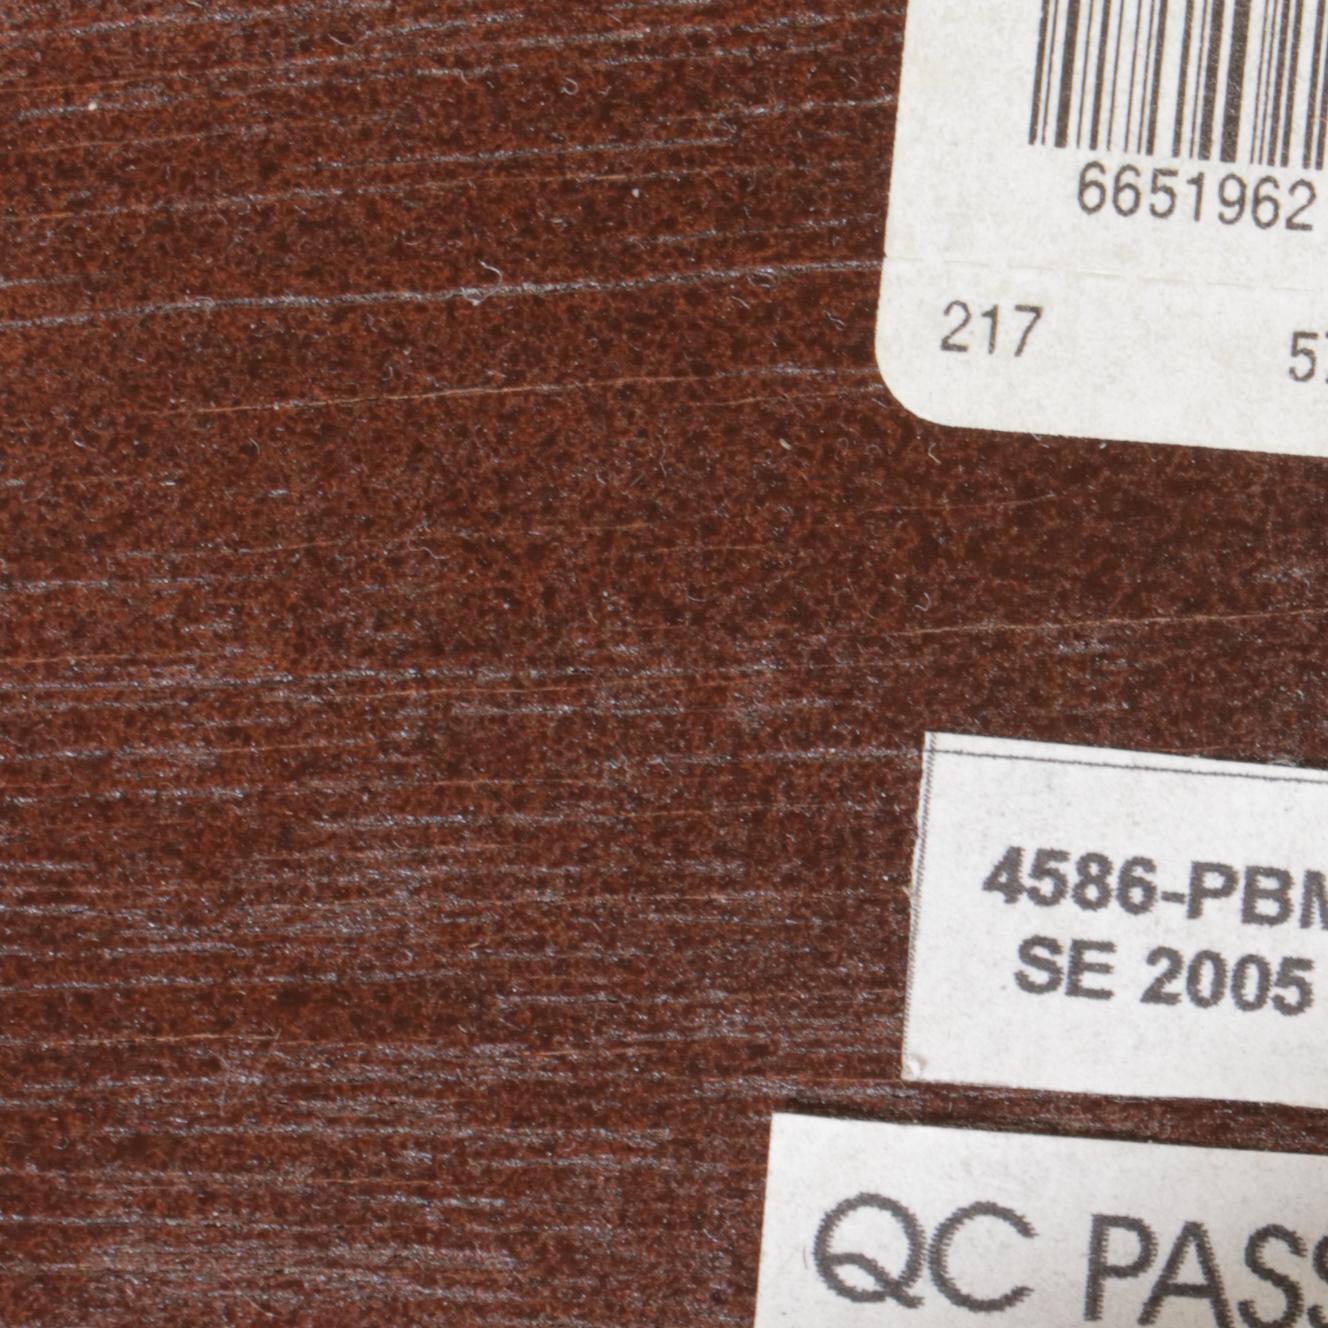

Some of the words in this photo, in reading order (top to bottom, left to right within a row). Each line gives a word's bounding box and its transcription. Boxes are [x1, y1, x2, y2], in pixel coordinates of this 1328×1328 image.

[1076, 161, 1318, 232] 6651962
[939, 300, 1044, 357] 217
[1013, 934, 1117, 1001] SE
[1139, 947, 1316, 1017] 2005
[812, 1192, 1037, 1312] QC
